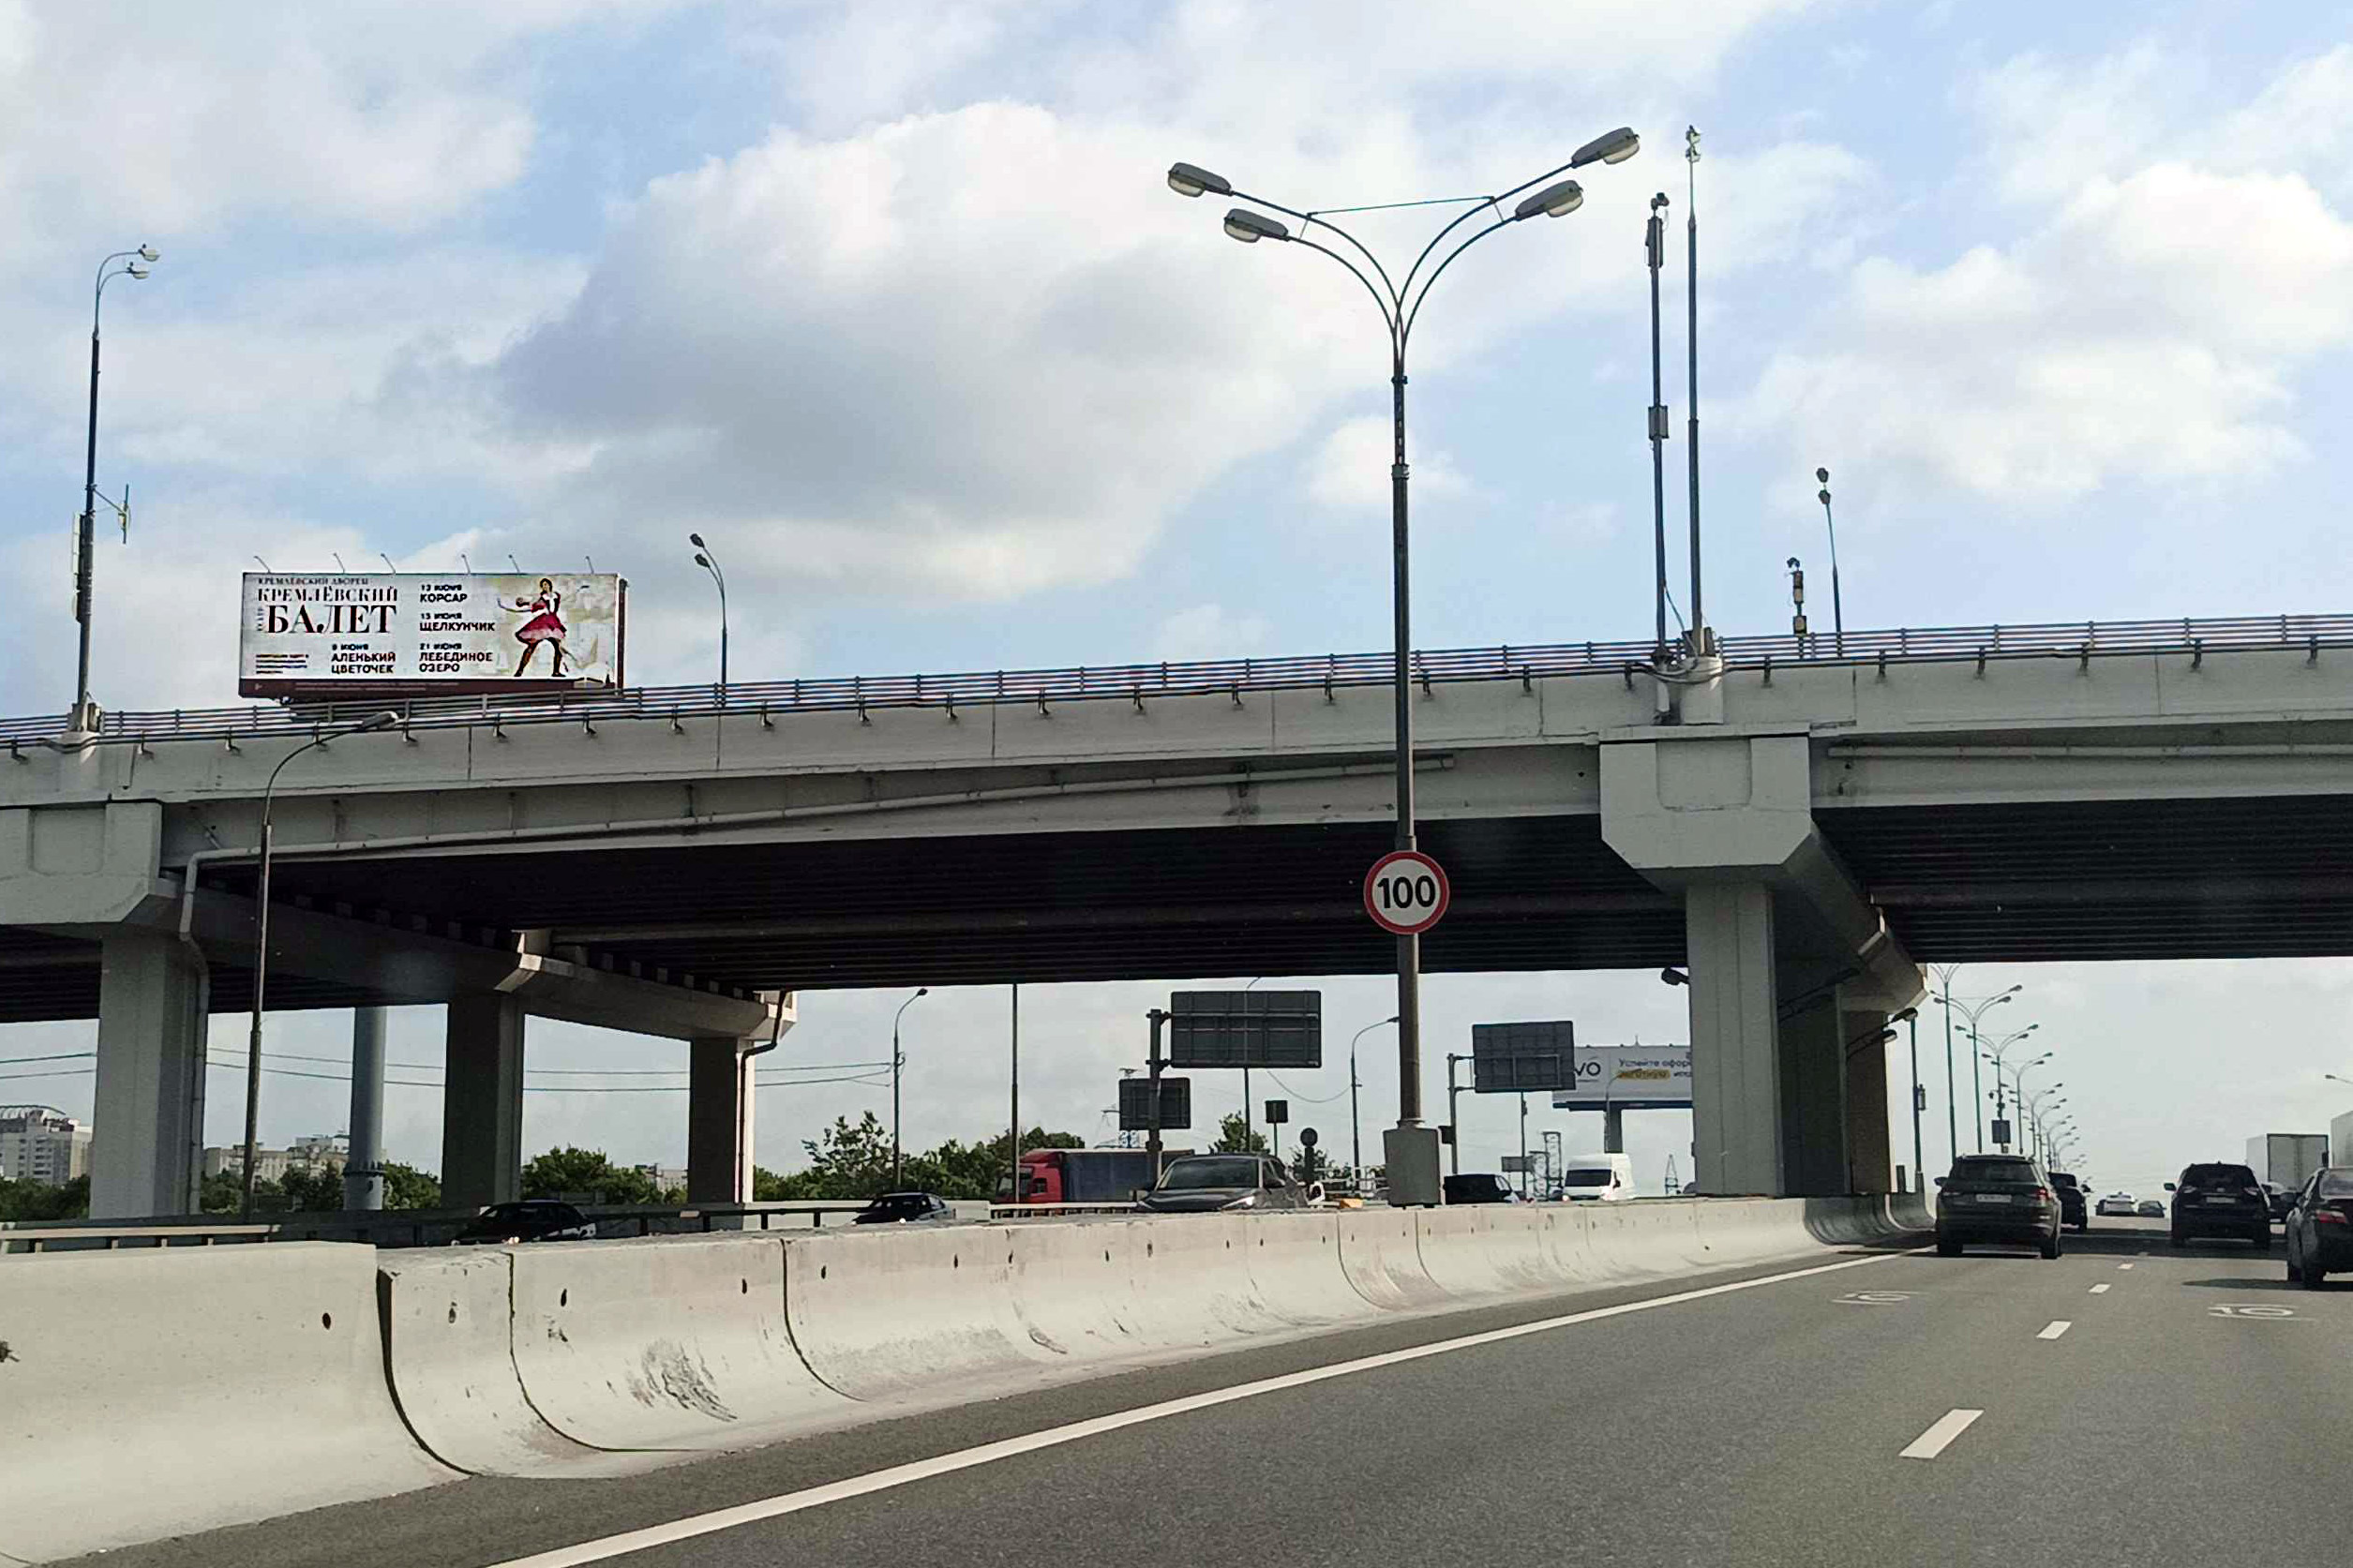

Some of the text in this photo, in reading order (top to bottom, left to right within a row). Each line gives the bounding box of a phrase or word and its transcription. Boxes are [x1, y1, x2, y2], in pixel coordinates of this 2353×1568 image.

[420, 593, 468, 603] КОРСАР
[266, 605, 397, 634] БАЛЕТ
[419, 621, 496, 632] ЩЕЛКУНЧИК
[331, 651, 396, 662] АЛЕНЬКИЙ
[419, 652, 494, 662] ЛЕБЕДИНОЕ
[331, 665, 394, 675] ЦВЕТОЧЕК
[419, 663, 460, 672] ОЗЕРО
[1377, 875, 1435, 908] 100
